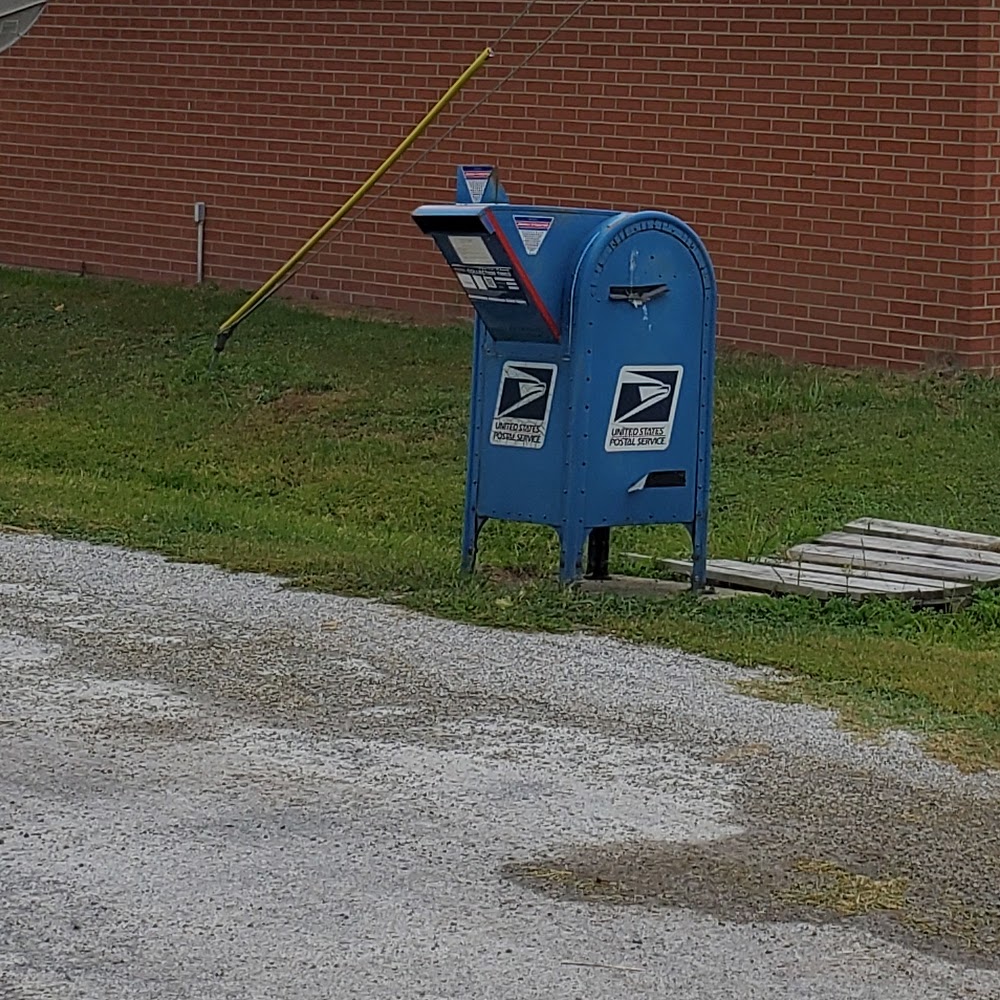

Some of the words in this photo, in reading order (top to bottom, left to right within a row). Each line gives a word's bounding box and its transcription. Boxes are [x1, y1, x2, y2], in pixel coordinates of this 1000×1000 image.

[495, 421, 518, 432] UNITED
[611, 426, 638, 437] UNITED
[639, 426, 664, 437] STATES
[609, 437, 636, 447] POSTAL
[636, 436, 666, 447] SERVICE
